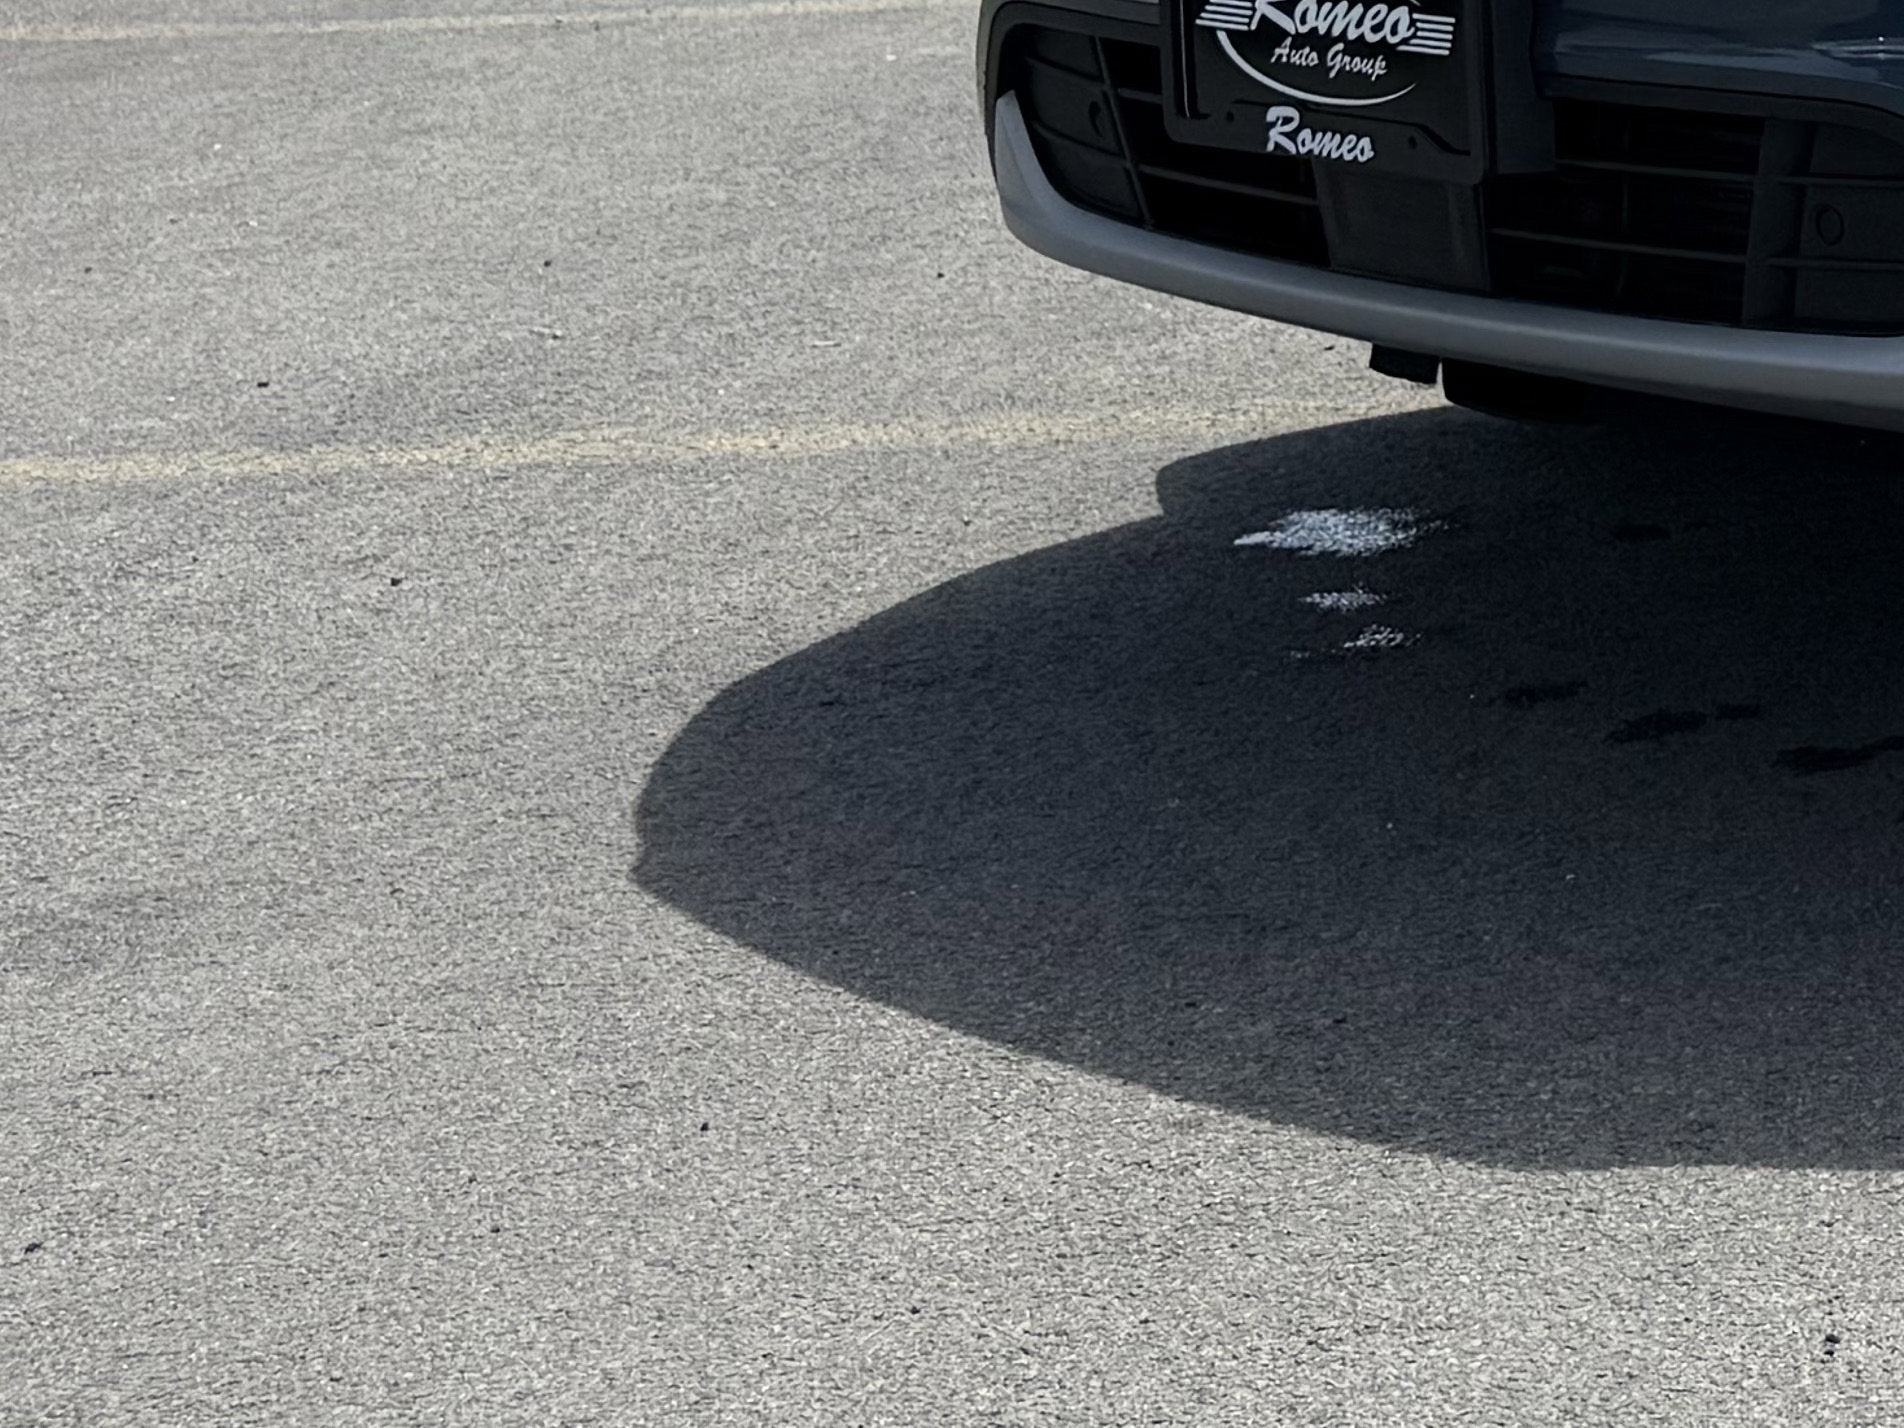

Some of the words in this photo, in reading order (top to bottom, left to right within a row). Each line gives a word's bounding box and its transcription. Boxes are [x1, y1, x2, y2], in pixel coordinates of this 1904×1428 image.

[1270, 36, 1320, 66] Auto
[1326, 42, 1388, 82] Group
[1265, 105, 1376, 163] Romeo
